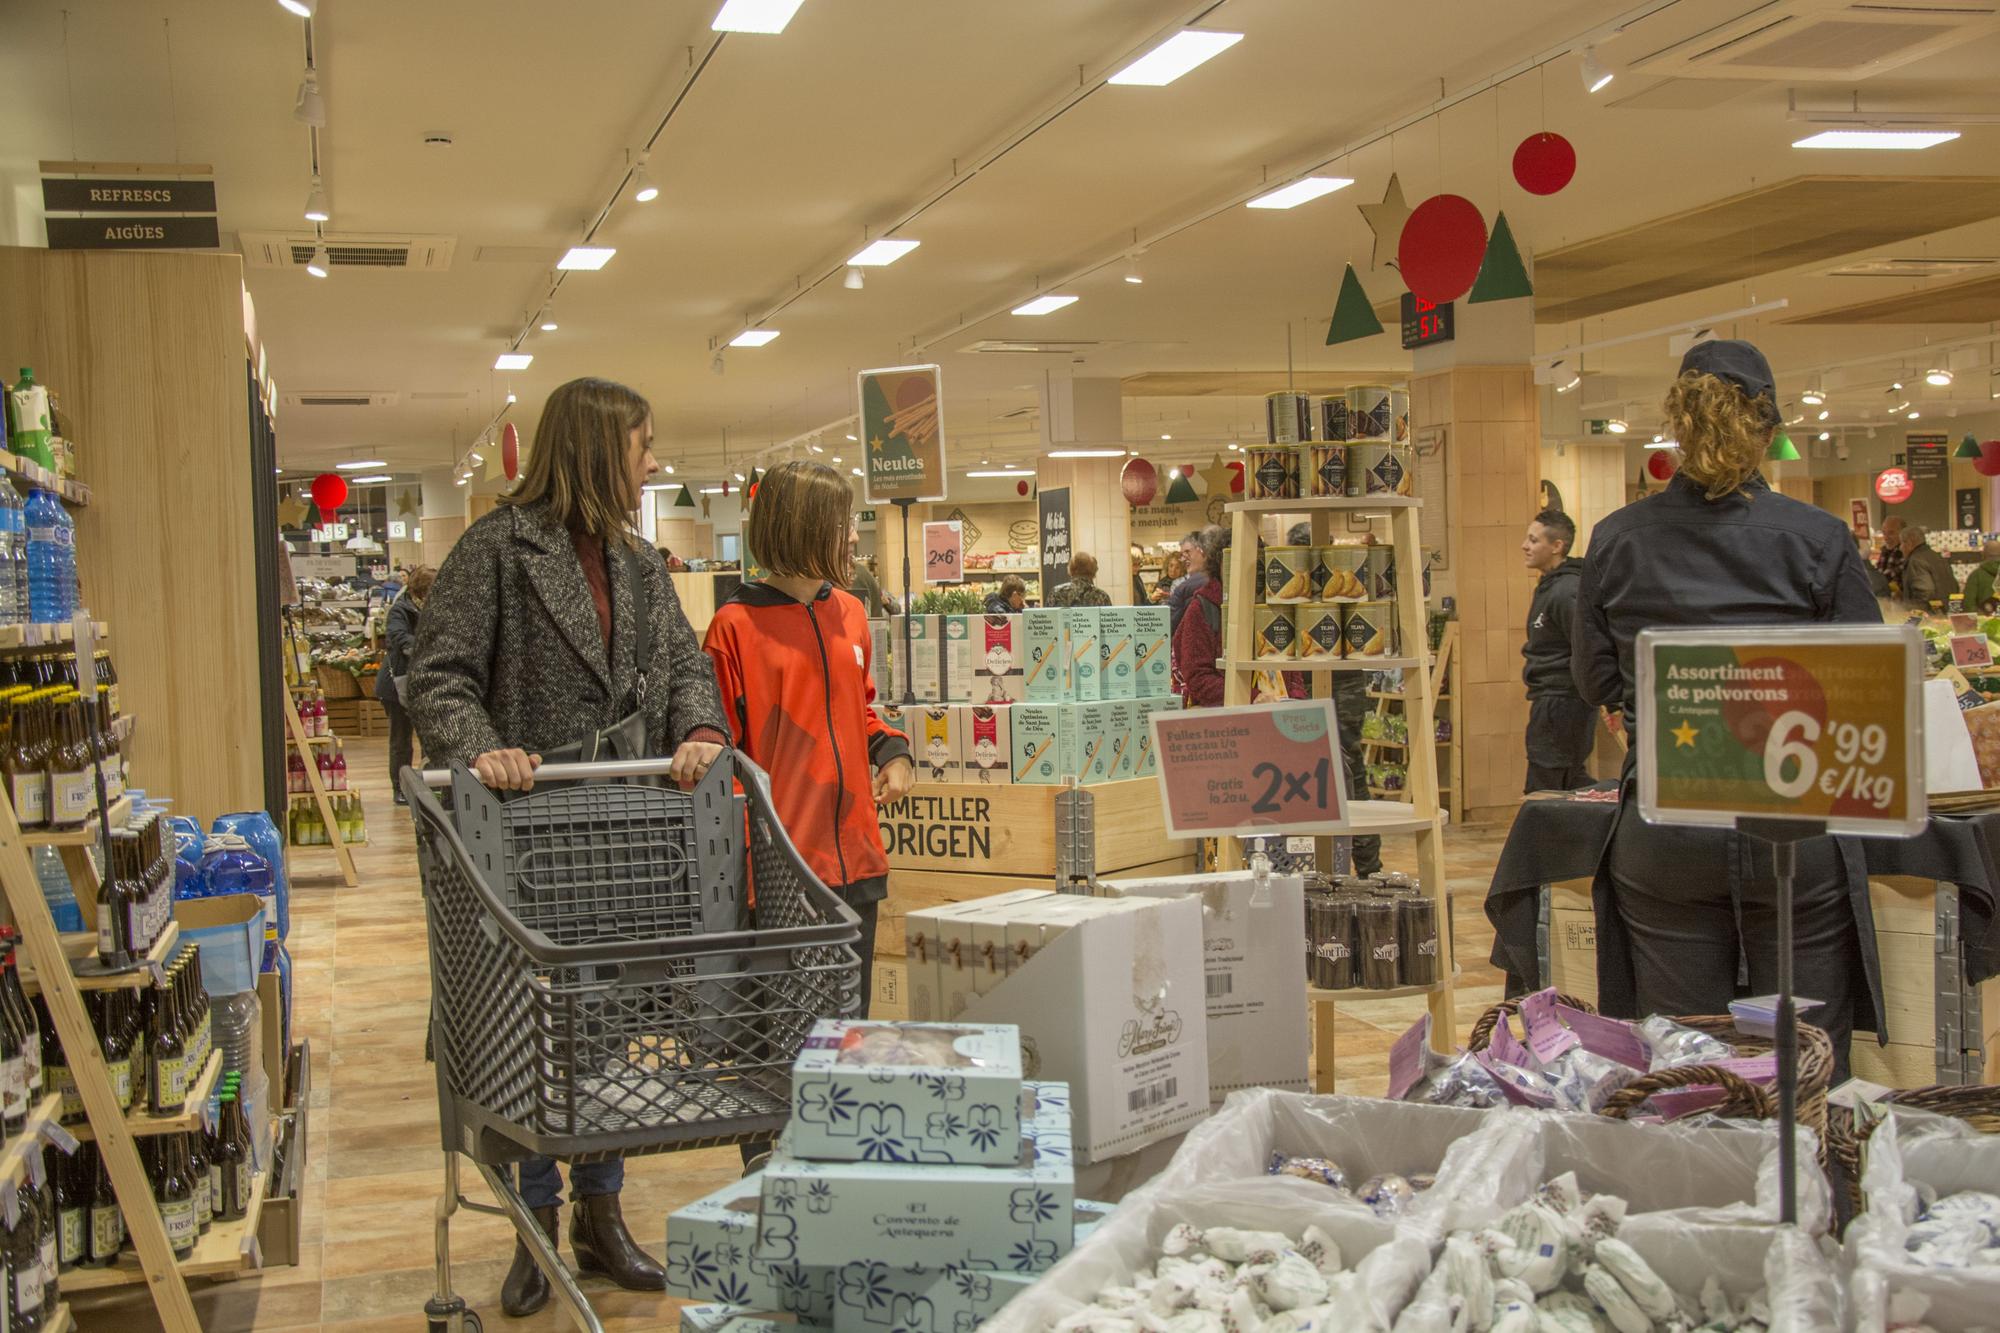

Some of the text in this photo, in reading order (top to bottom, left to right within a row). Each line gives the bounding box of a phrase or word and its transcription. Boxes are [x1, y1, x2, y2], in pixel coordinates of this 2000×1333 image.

[90, 189, 171, 202] REFRESCS
[105, 225, 165, 240] AIGÜES
[872, 456, 924, 472] Neules
[1138, 518, 1178, 528] menjant
[1667, 664, 1785, 681] Assortiment
[1667, 685, 1788, 703] de polvorons
[1166, 727, 1250, 742] Fulles farcides
[1168, 742, 1183, 752] de
[1185, 741, 1218, 751] cacau
[1170, 750, 1240, 764] tradicionals
[1207, 779, 1244, 792] Gratis
[1252, 757, 1329, 814] 2x1
[1819, 766, 1895, 809] €/kg
[1209, 793, 1220, 804] la
[878, 822, 991, 859] ORIGEN
[873, 1213, 960, 1226] Convento de
[877, 1227, 955, 1240] Antequera
